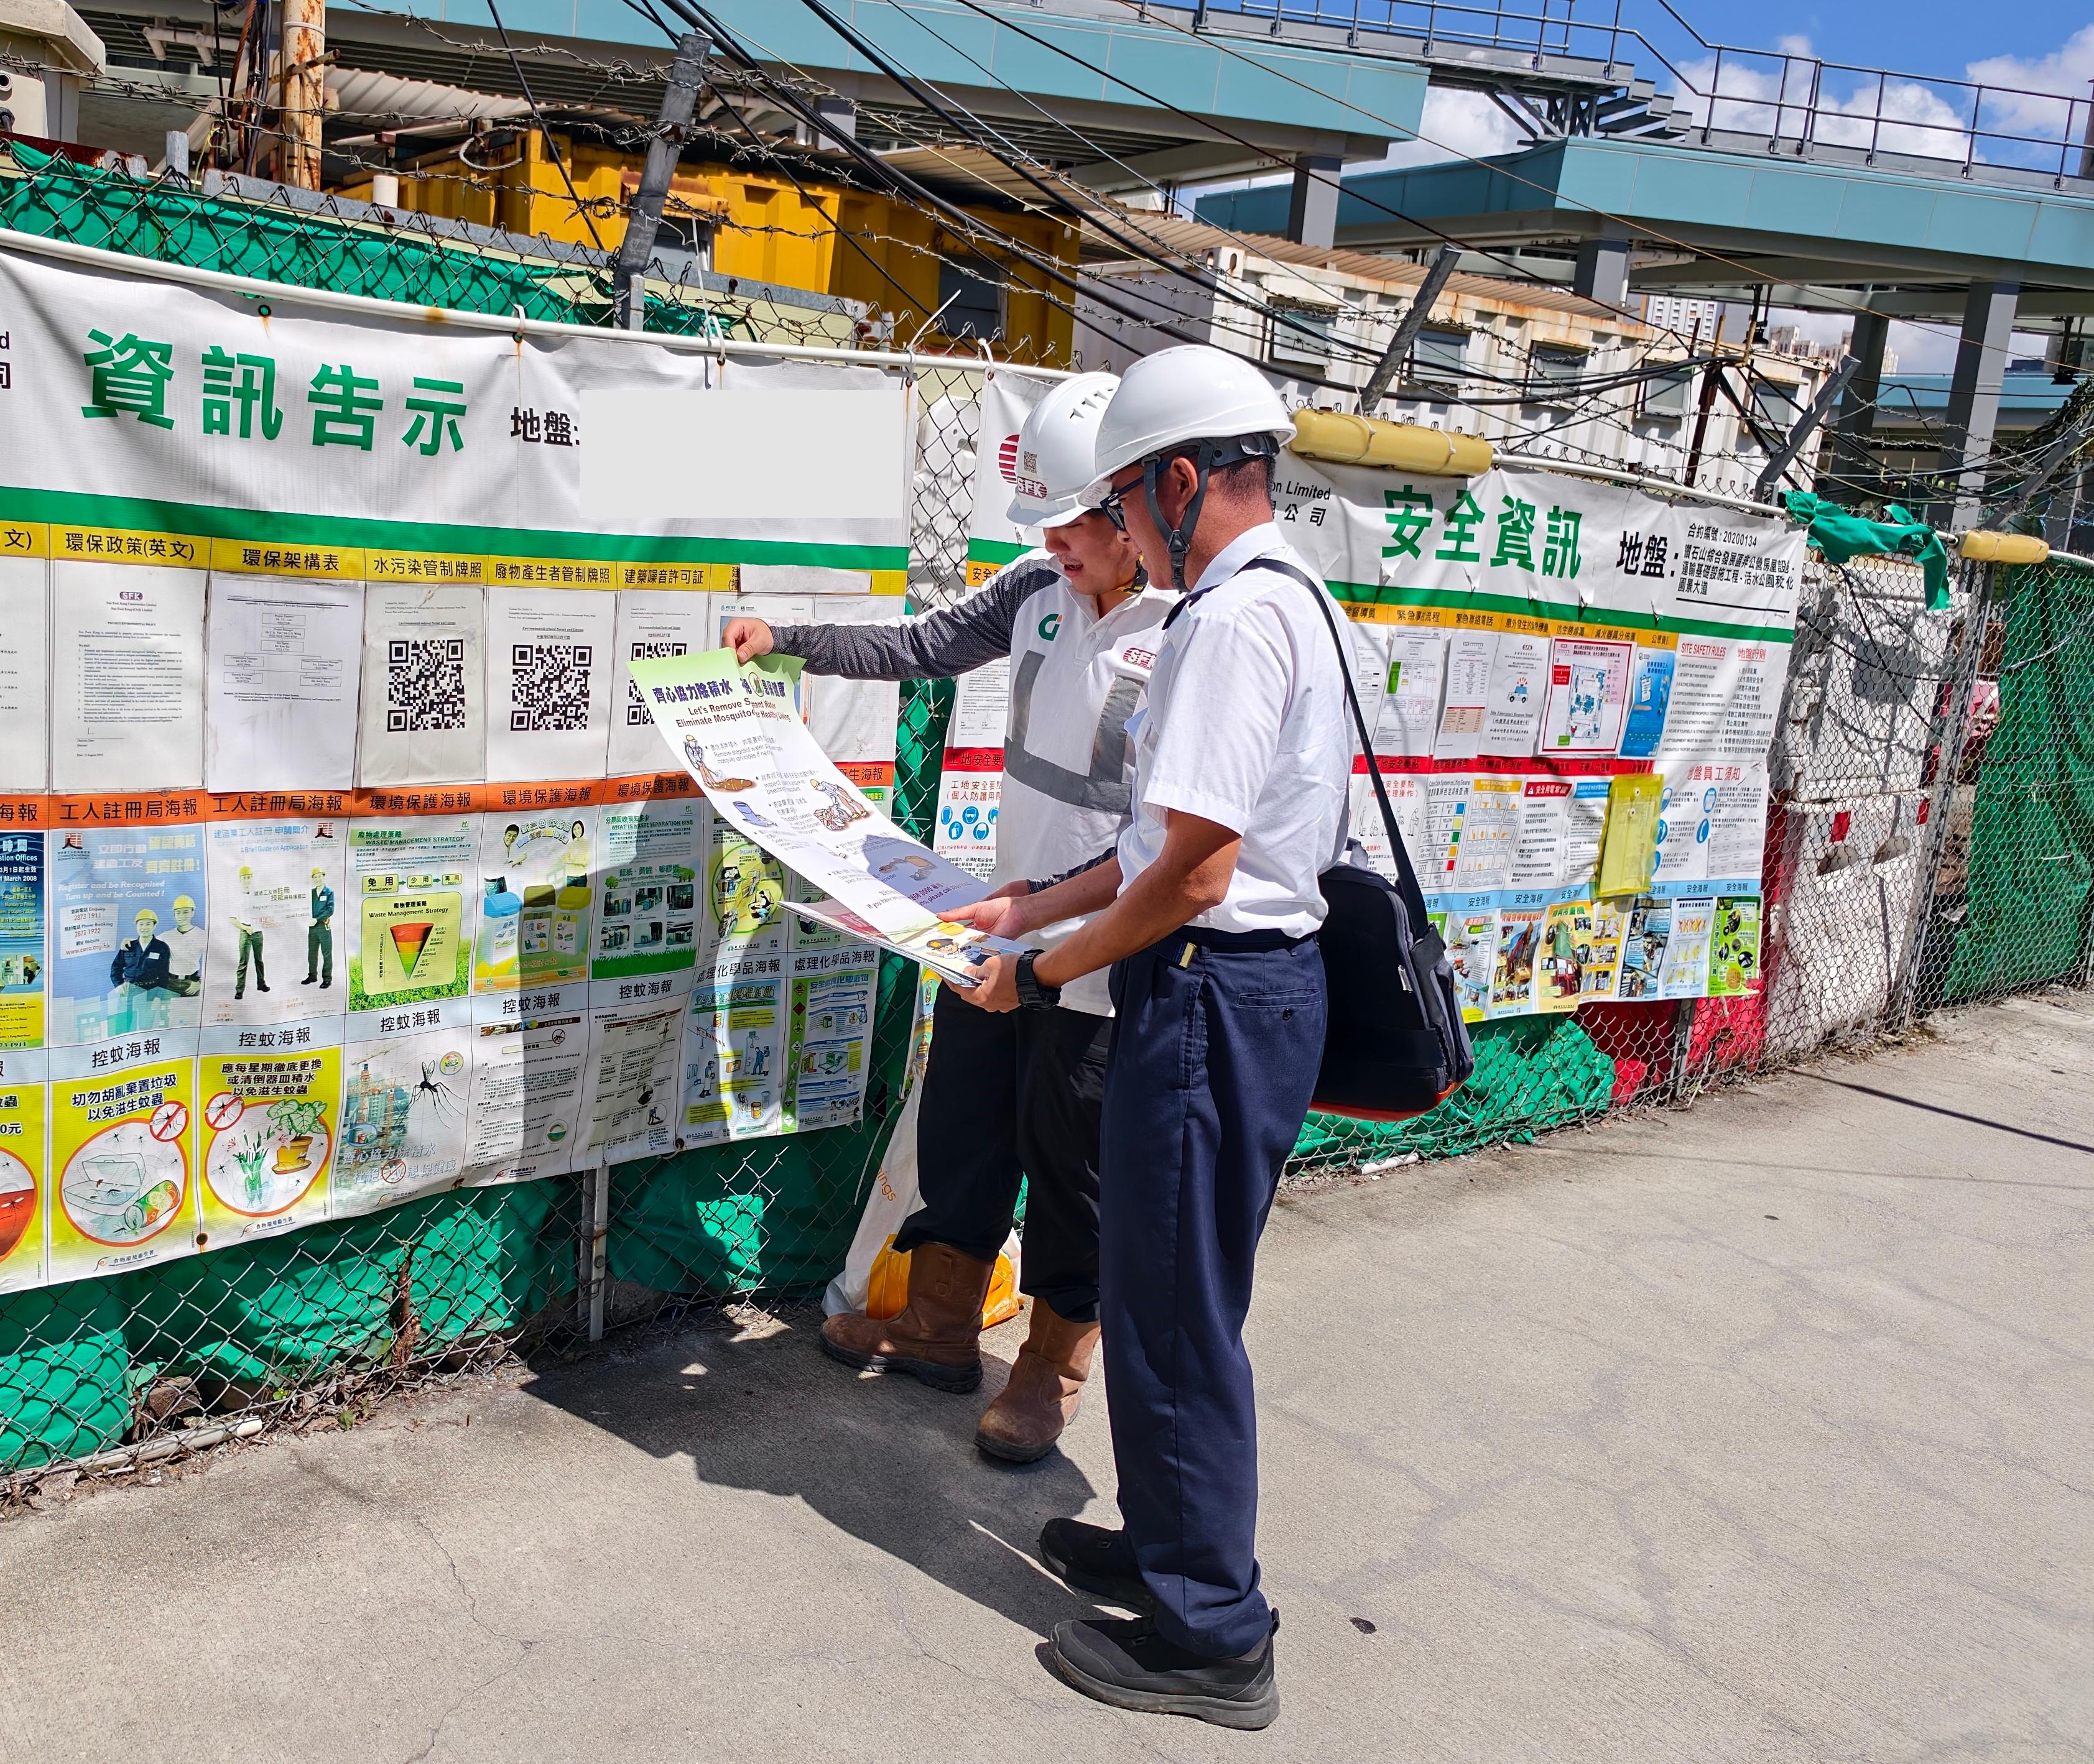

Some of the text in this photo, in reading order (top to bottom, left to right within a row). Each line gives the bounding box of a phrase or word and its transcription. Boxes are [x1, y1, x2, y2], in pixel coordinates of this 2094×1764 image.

[81, 328, 468, 456] 資訊告示
[1017, 476, 1045, 498] SFK
[1286, 481, 1331, 501] Limited
[1381, 484, 1583, 580] 安全資訊
[1723, 530, 1757, 548] 20200134
[65, 532, 195, 561] 環保政策(英文)
[242, 548, 340, 571] 環保架構表
[373, 556, 483, 578] 水污染管制牌照
[495, 563, 610, 583] 廢物產生者管制牌照
[624, 568, 705, 585] 建築噪音許可証
[120, 591, 143, 601] SFK
[1677, 577, 1708, 596] 園景大道
[1681, 642, 1726, 657] SITE SAFETY RULES
[652, 678, 733, 704] 齊心協力除積水
[688, 704, 708, 716] Let's
[708, 701, 743, 714] Remove
[675, 716, 713, 727] Eliminate
[948, 752, 1004, 767] 工地安全要
[502, 787, 592, 806] 環境保護海報
[616, 777, 690, 798] 環境保護海報
[60, 798, 198, 820] 工人註冊局海報
[213, 795, 343, 814] 工人註冊局海報
[369, 792, 471, 811] 環境保護海報
[2, 839, 29, 852] 時間
[58, 880, 165, 892] Register and be Recognised
[1686, 884, 1708, 894] 安全海報
[1726, 882, 1748, 892] 安全海報
[83, 894, 93, 902] up
[929, 892, 943, 903] please
[1468, 895, 1491, 907] 安全海報
[1514, 894, 1544, 904] 安全海報
[387, 908, 424, 917] Management
[794, 949, 875, 971] 處理化學品海報
[697, 959, 781, 984] 處理化學品海報
[619, 979, 672, 1000] 控蚊海報
[503, 992, 560, 1015] 控蚊海報
[380, 1008, 440, 1033] 控蚊海報
[238, 1027, 311, 1047] 控蚊海報
[91, 1038, 160, 1068] 控蚊海報
[221, 1058, 322, 1073] 應每星期徹底更換
[227, 1073, 315, 1086] 或清倒器皿積水
[72, 1073, 177, 1107] 切勿胡亂棄置垃圾
[233, 1085, 308, 1096] 以免滋生蚊蟲
[87, 1092, 164, 1122] 以免滋生蚊蟲
[343, 1142, 436, 1165] 齊心協力除積水
